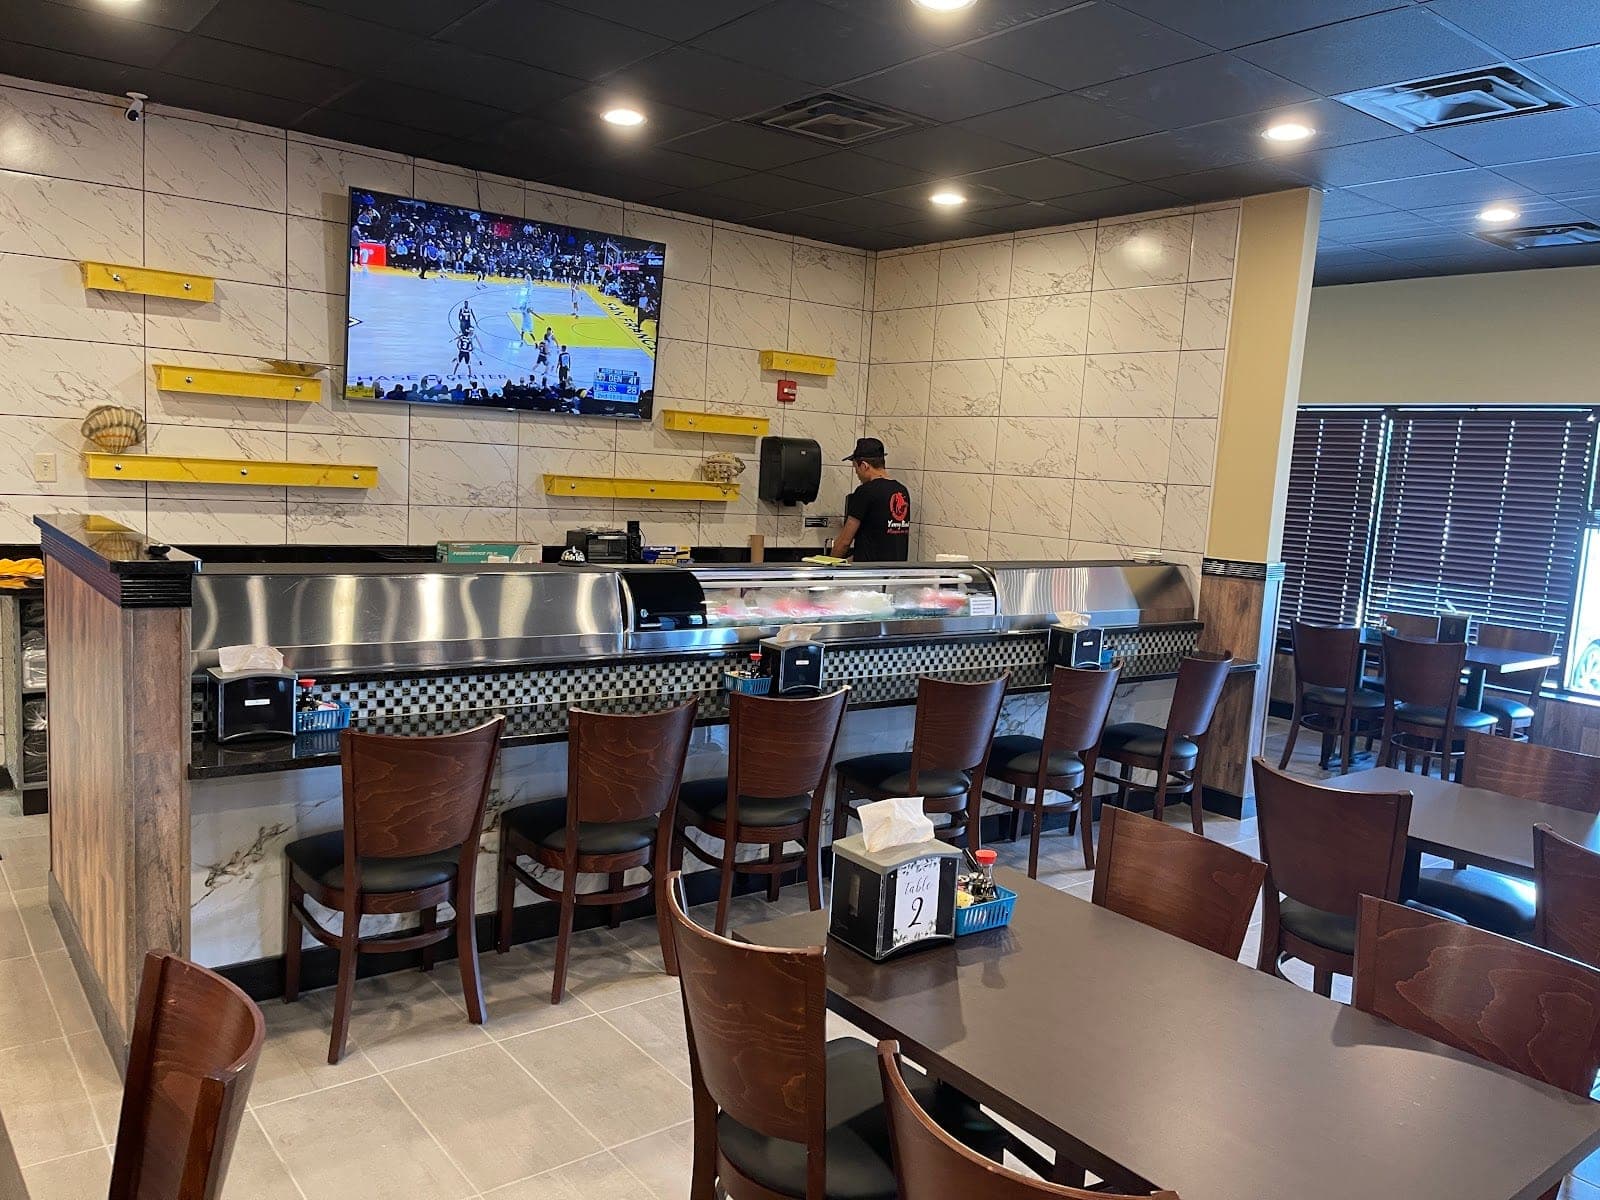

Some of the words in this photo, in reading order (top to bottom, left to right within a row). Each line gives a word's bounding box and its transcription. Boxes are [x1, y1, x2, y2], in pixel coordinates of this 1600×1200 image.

[608, 375, 623, 384] DEN
[628, 376, 637, 385] 41
[608, 384, 617, 392] GS
[626, 386, 637, 394] 28
[907, 897, 924, 928] 2
